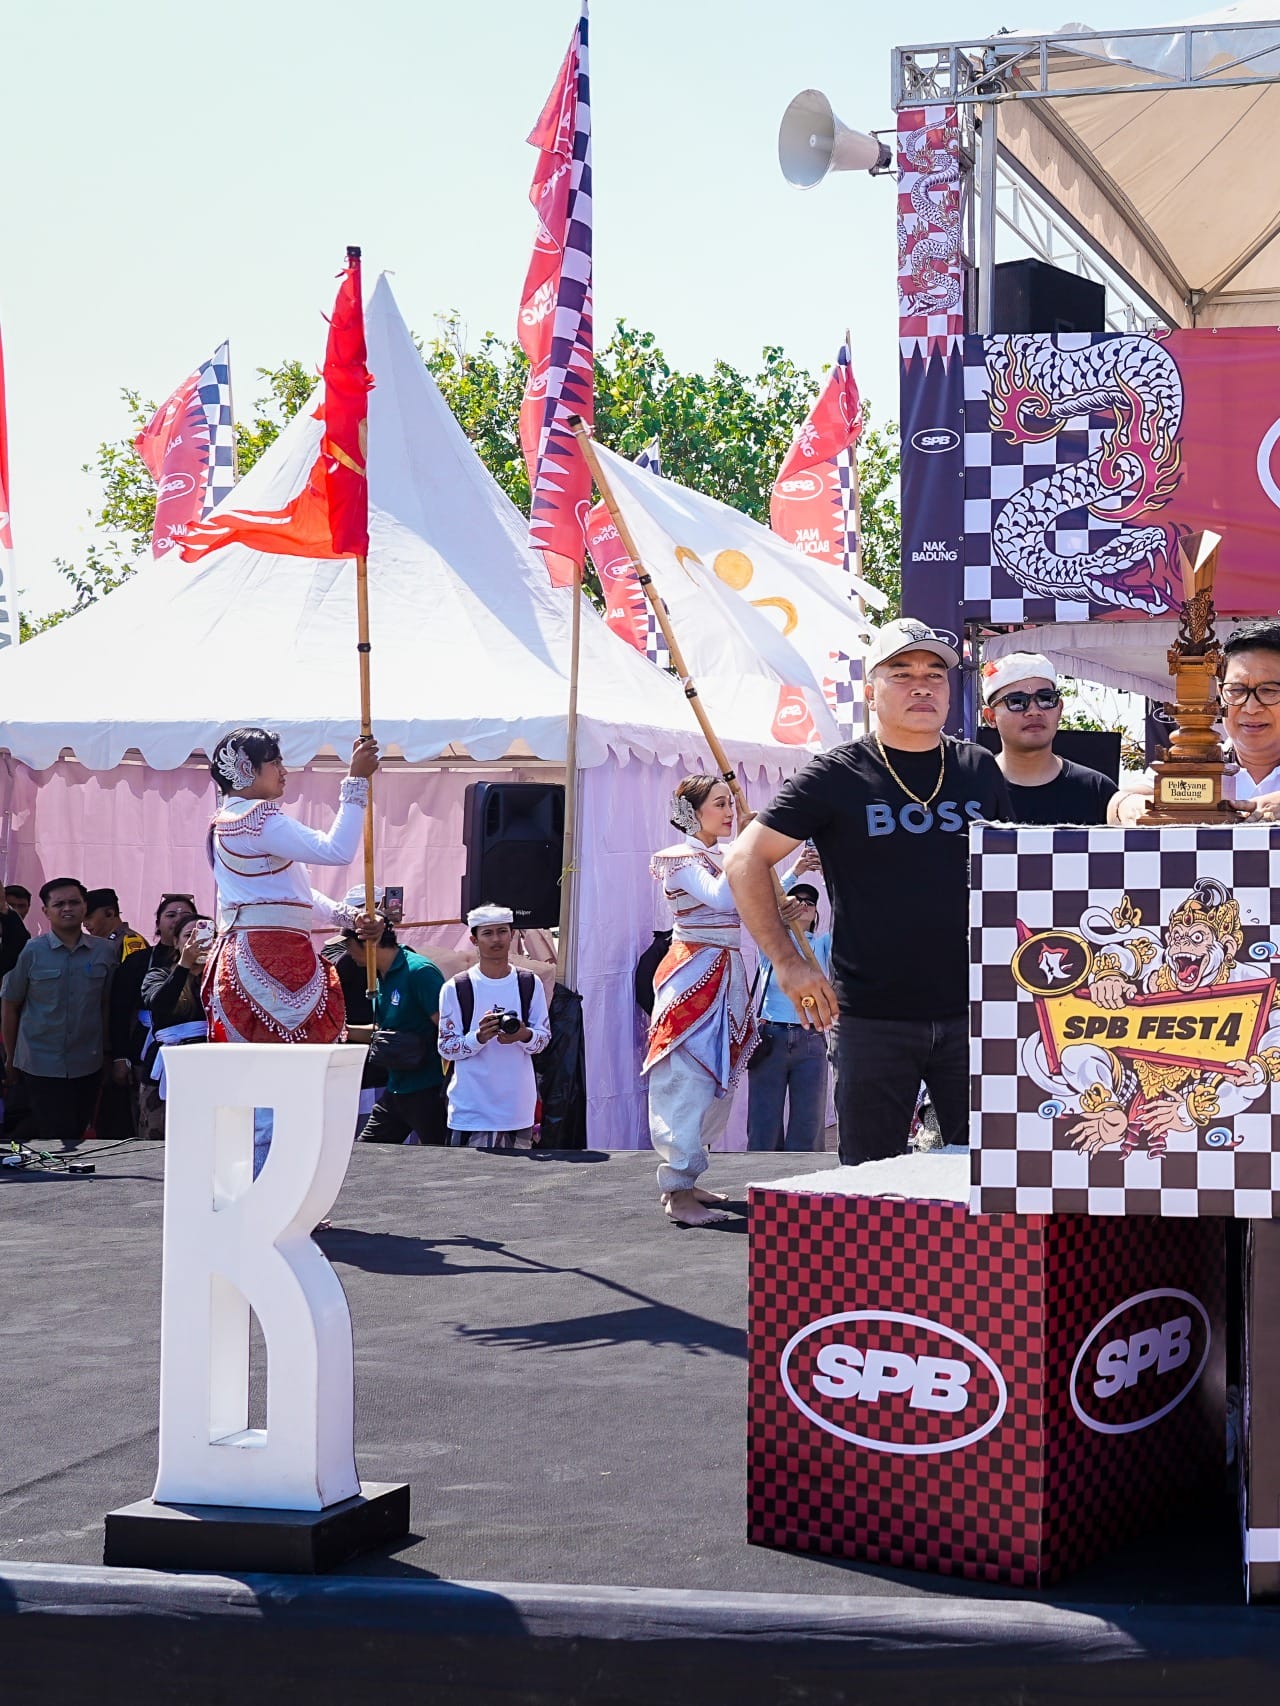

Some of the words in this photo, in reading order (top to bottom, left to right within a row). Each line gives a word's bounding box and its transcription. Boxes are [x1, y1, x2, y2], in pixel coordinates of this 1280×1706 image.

[921, 435, 951, 446] SPB
[923, 541, 946, 552] NAK
[912, 551, 957, 561] BADUNG
[1171, 789, 1202, 798] Badung
[866, 801, 984, 836] BOSS
[1063, 1016, 1129, 1041] SPB
[1093, 1316, 1191, 1398] SPB
[812, 1344, 971, 1413] SPB
